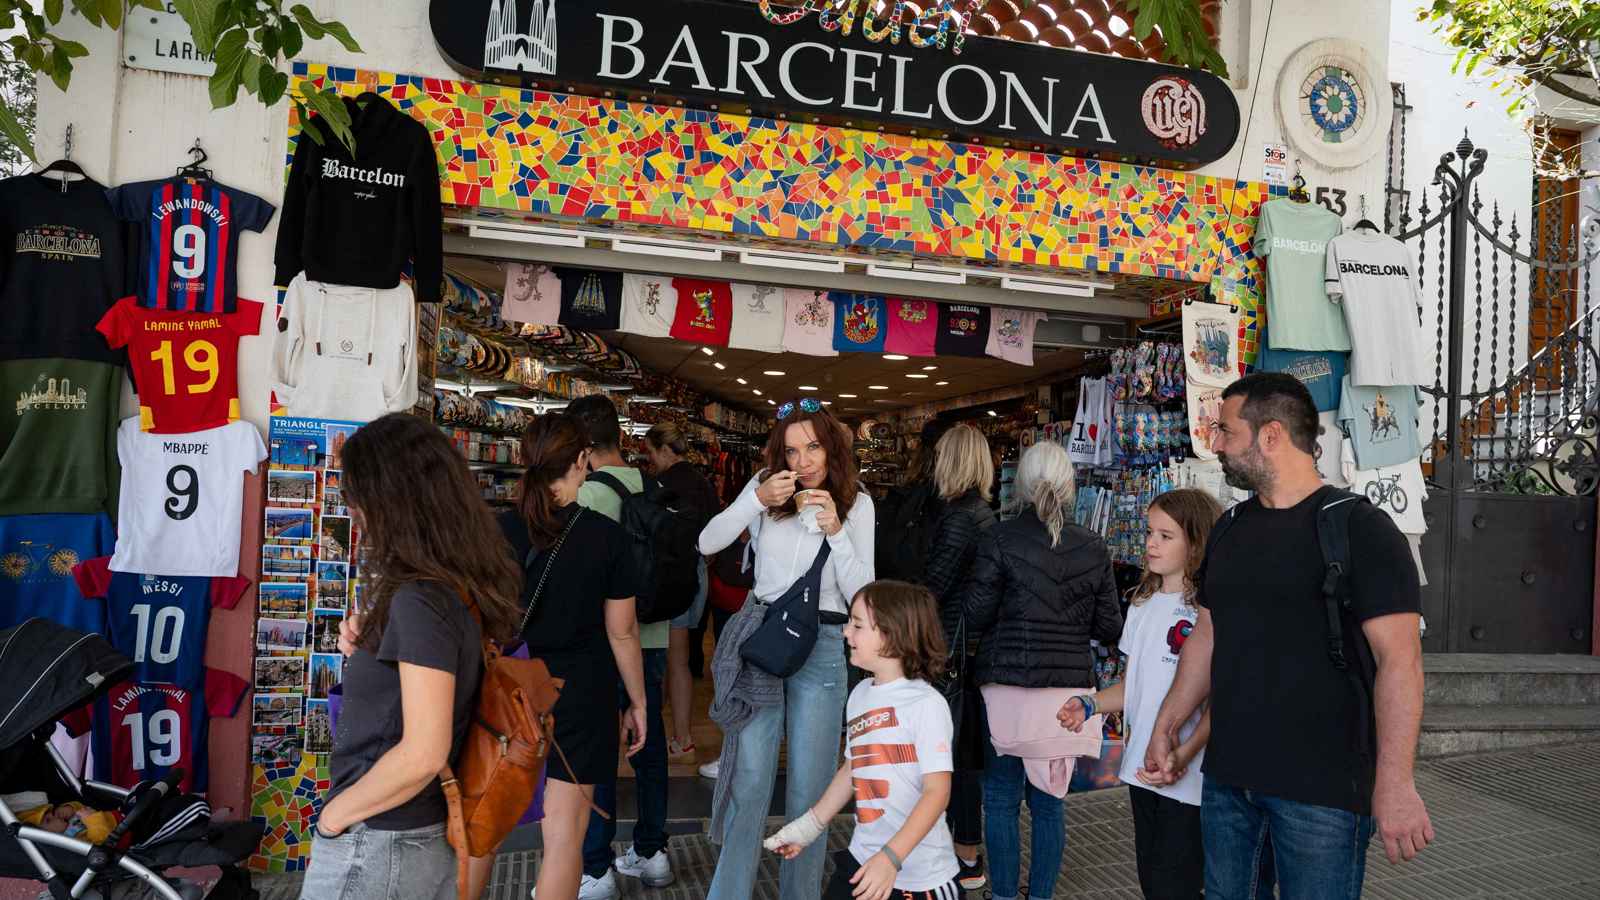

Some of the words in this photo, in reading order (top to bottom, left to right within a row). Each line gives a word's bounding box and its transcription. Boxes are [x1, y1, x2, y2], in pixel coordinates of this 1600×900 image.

[596, 13, 1117, 144] BARCELONA
[152, 198, 229, 227] LEWANDOWSKI
[1315, 186, 1347, 217] 53
[16, 233, 100, 255] BARCELONA
[40, 253, 74, 262] SPAIN
[172, 224, 206, 279] 9
[1339, 262, 1409, 277] BARCELONA
[144, 320, 185, 332] LAMINE
[187, 317, 222, 331] YAMAL
[150, 339, 219, 395] 19
[16, 402, 87, 416] BCELONA
[163, 441, 209, 455] MBAPPÉ
[164, 464, 199, 521] 9
[142, 580, 184, 597] MESSI
[130, 603, 185, 664] 10
[120, 709, 181, 771] 19
